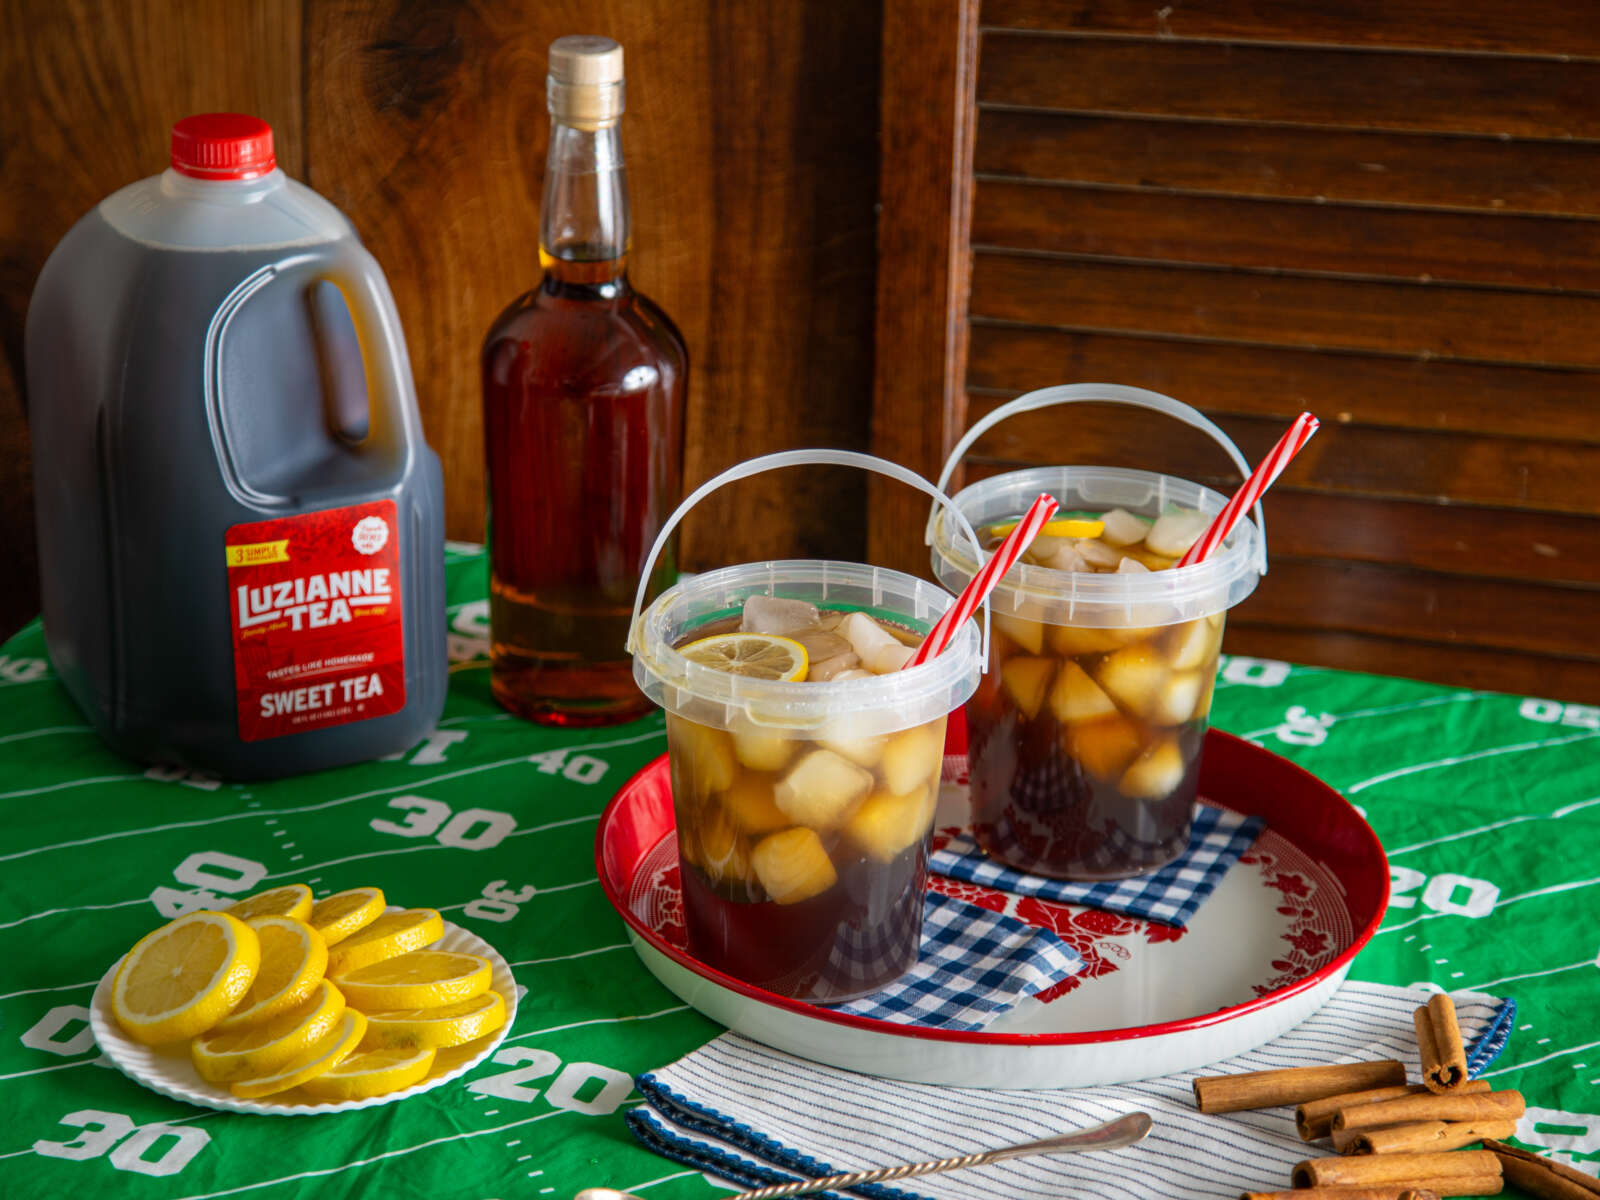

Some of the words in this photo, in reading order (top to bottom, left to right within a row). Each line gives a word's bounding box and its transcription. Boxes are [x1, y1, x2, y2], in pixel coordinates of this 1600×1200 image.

[234, 547, 243, 564] 3
[246, 545, 278, 557] SIMPLE
[237, 568, 392, 629] LUZIANNE
[284, 599, 352, 632] TEA
[266, 664, 300, 681] TASTES
[302, 659, 322, 672] LIKE
[324, 652, 375, 668] HOMEMADE
[260, 683, 337, 718] SWEET
[340, 673, 383, 702] TEA
[528, 750, 610, 785] 40
[369, 795, 518, 851] 30
[463, 879, 537, 922] 30
[464, 1045, 636, 1116] 20
[32, 1109, 213, 1177] 30
